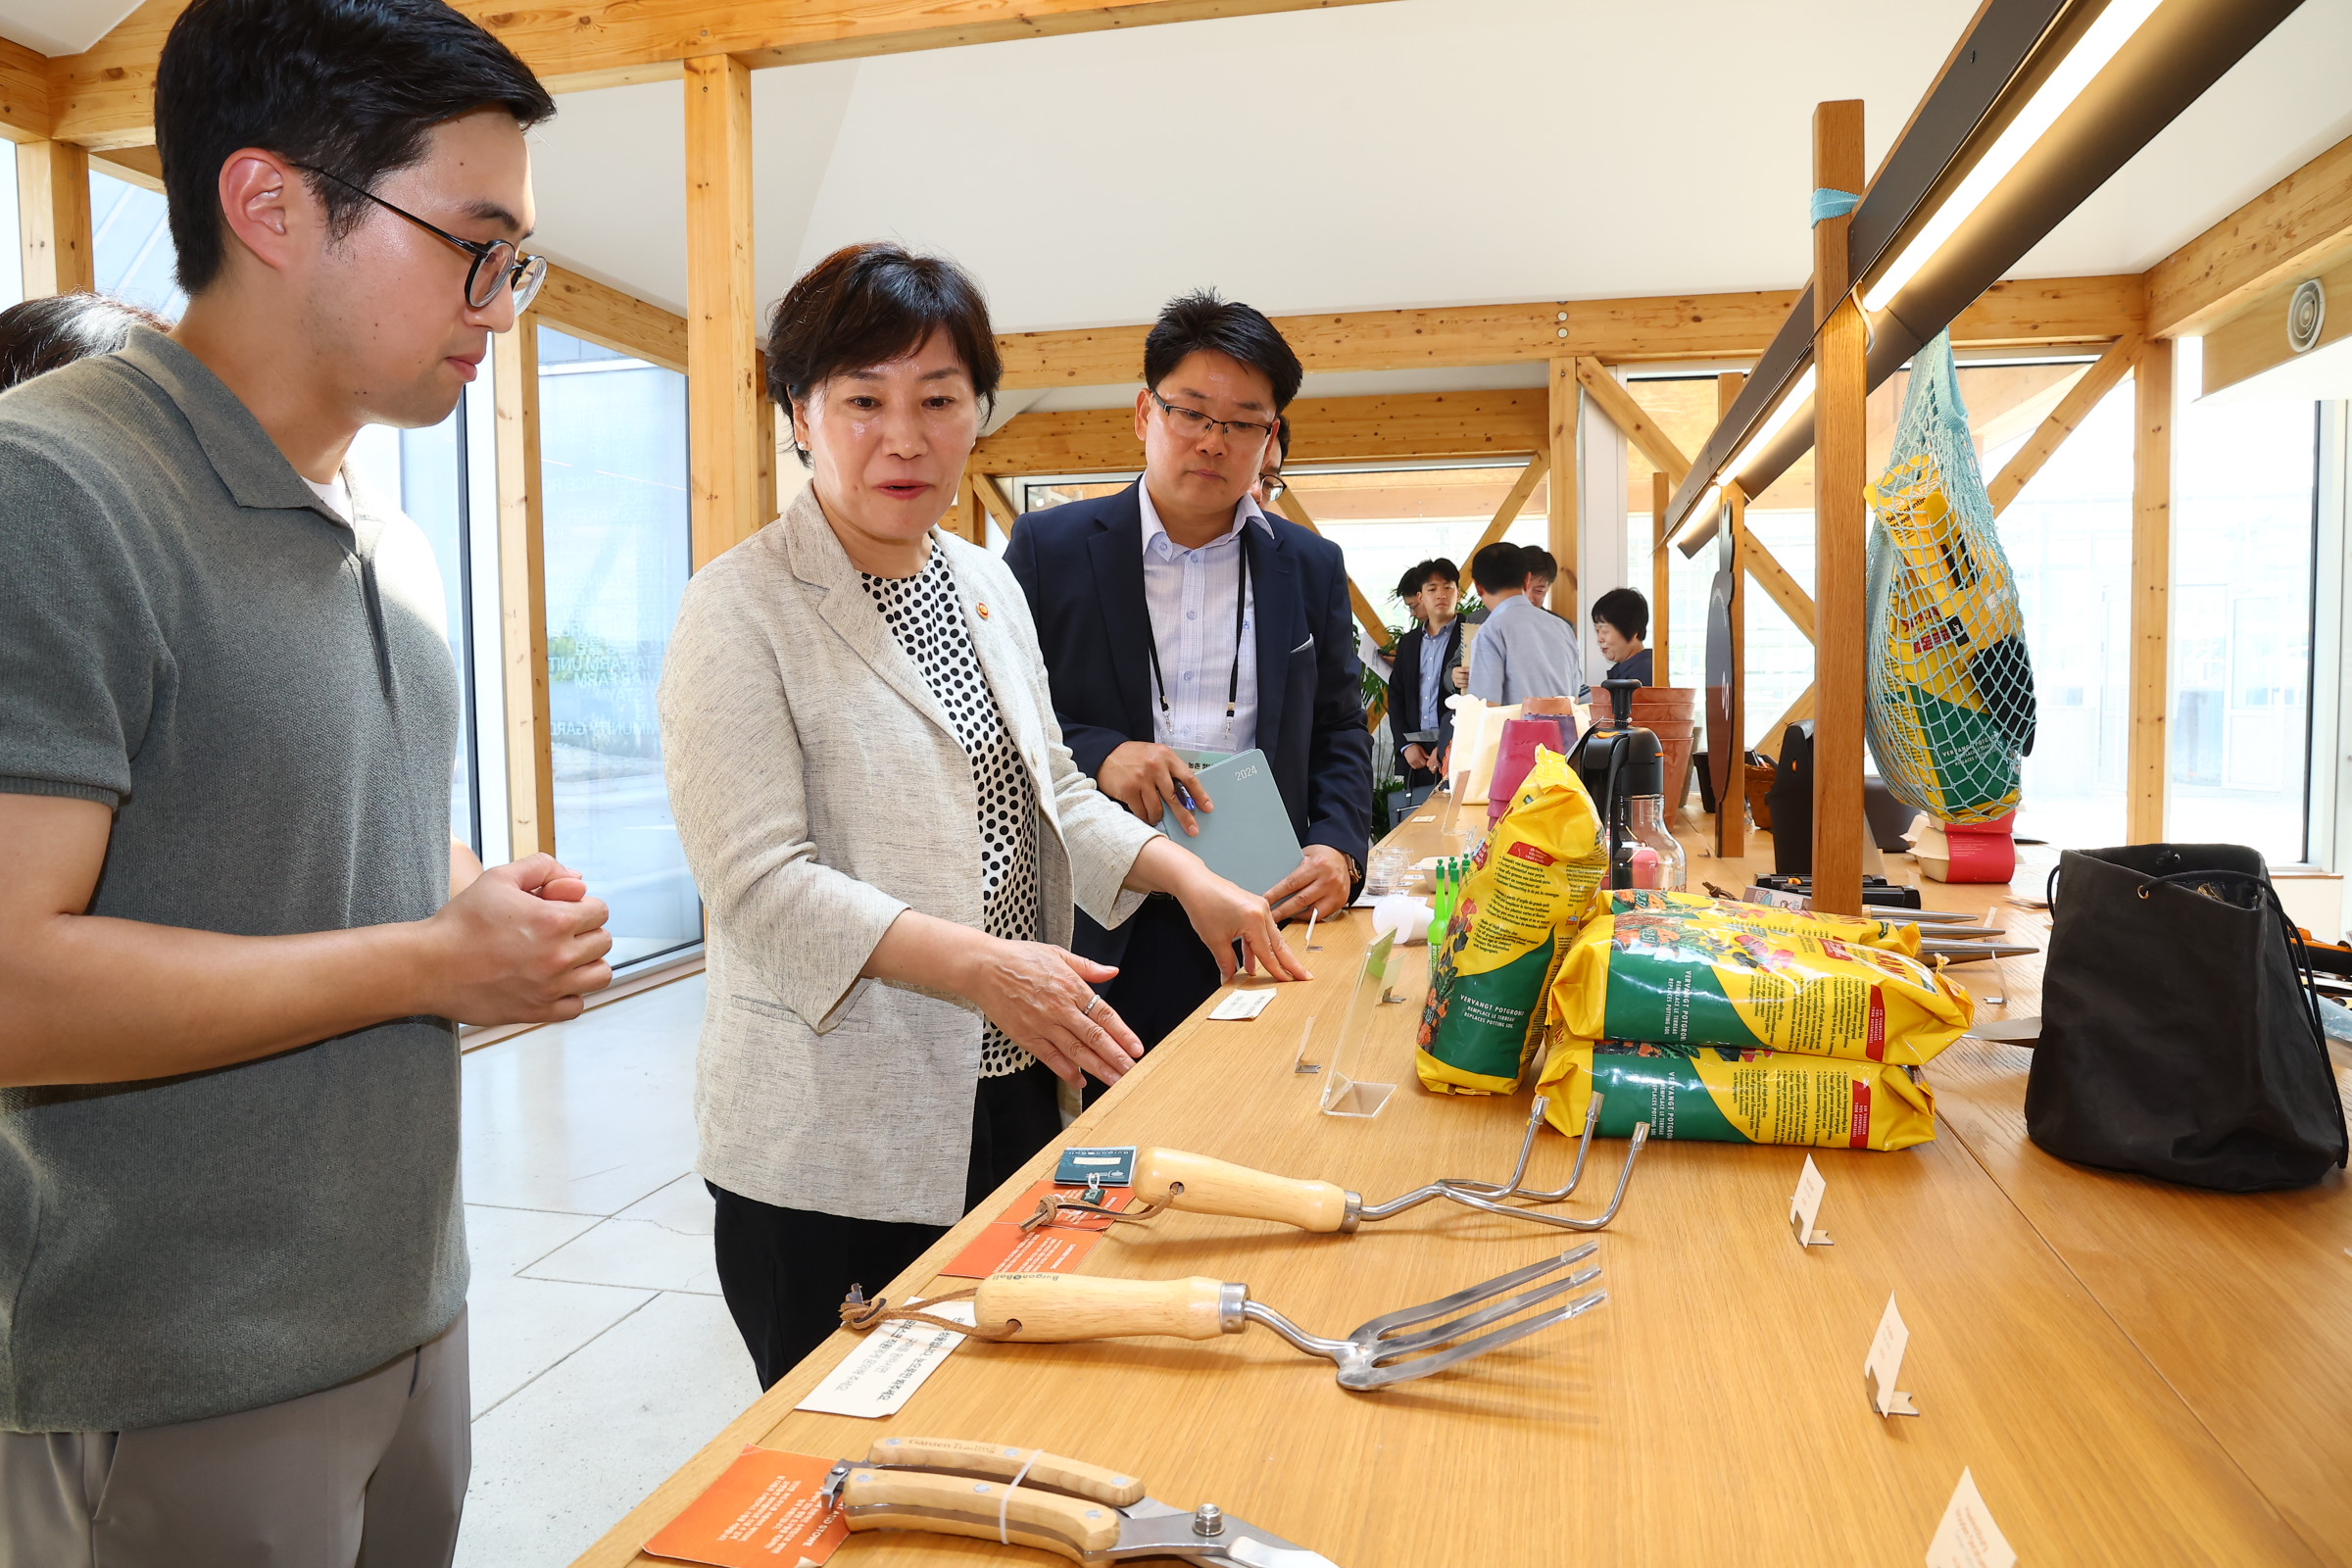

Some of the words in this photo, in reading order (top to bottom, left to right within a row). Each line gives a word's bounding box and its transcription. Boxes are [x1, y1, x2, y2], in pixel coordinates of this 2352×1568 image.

[1235, 764, 1258, 781] 2024
[1460, 994, 1494, 1010] VERVANGT
[902, 1353, 925, 1380] 눈으로만
[876, 1375, 905, 1401] 봐주세요
[909, 1439, 951, 1448] Garden
[803, 1524, 823, 1547] STOWE
